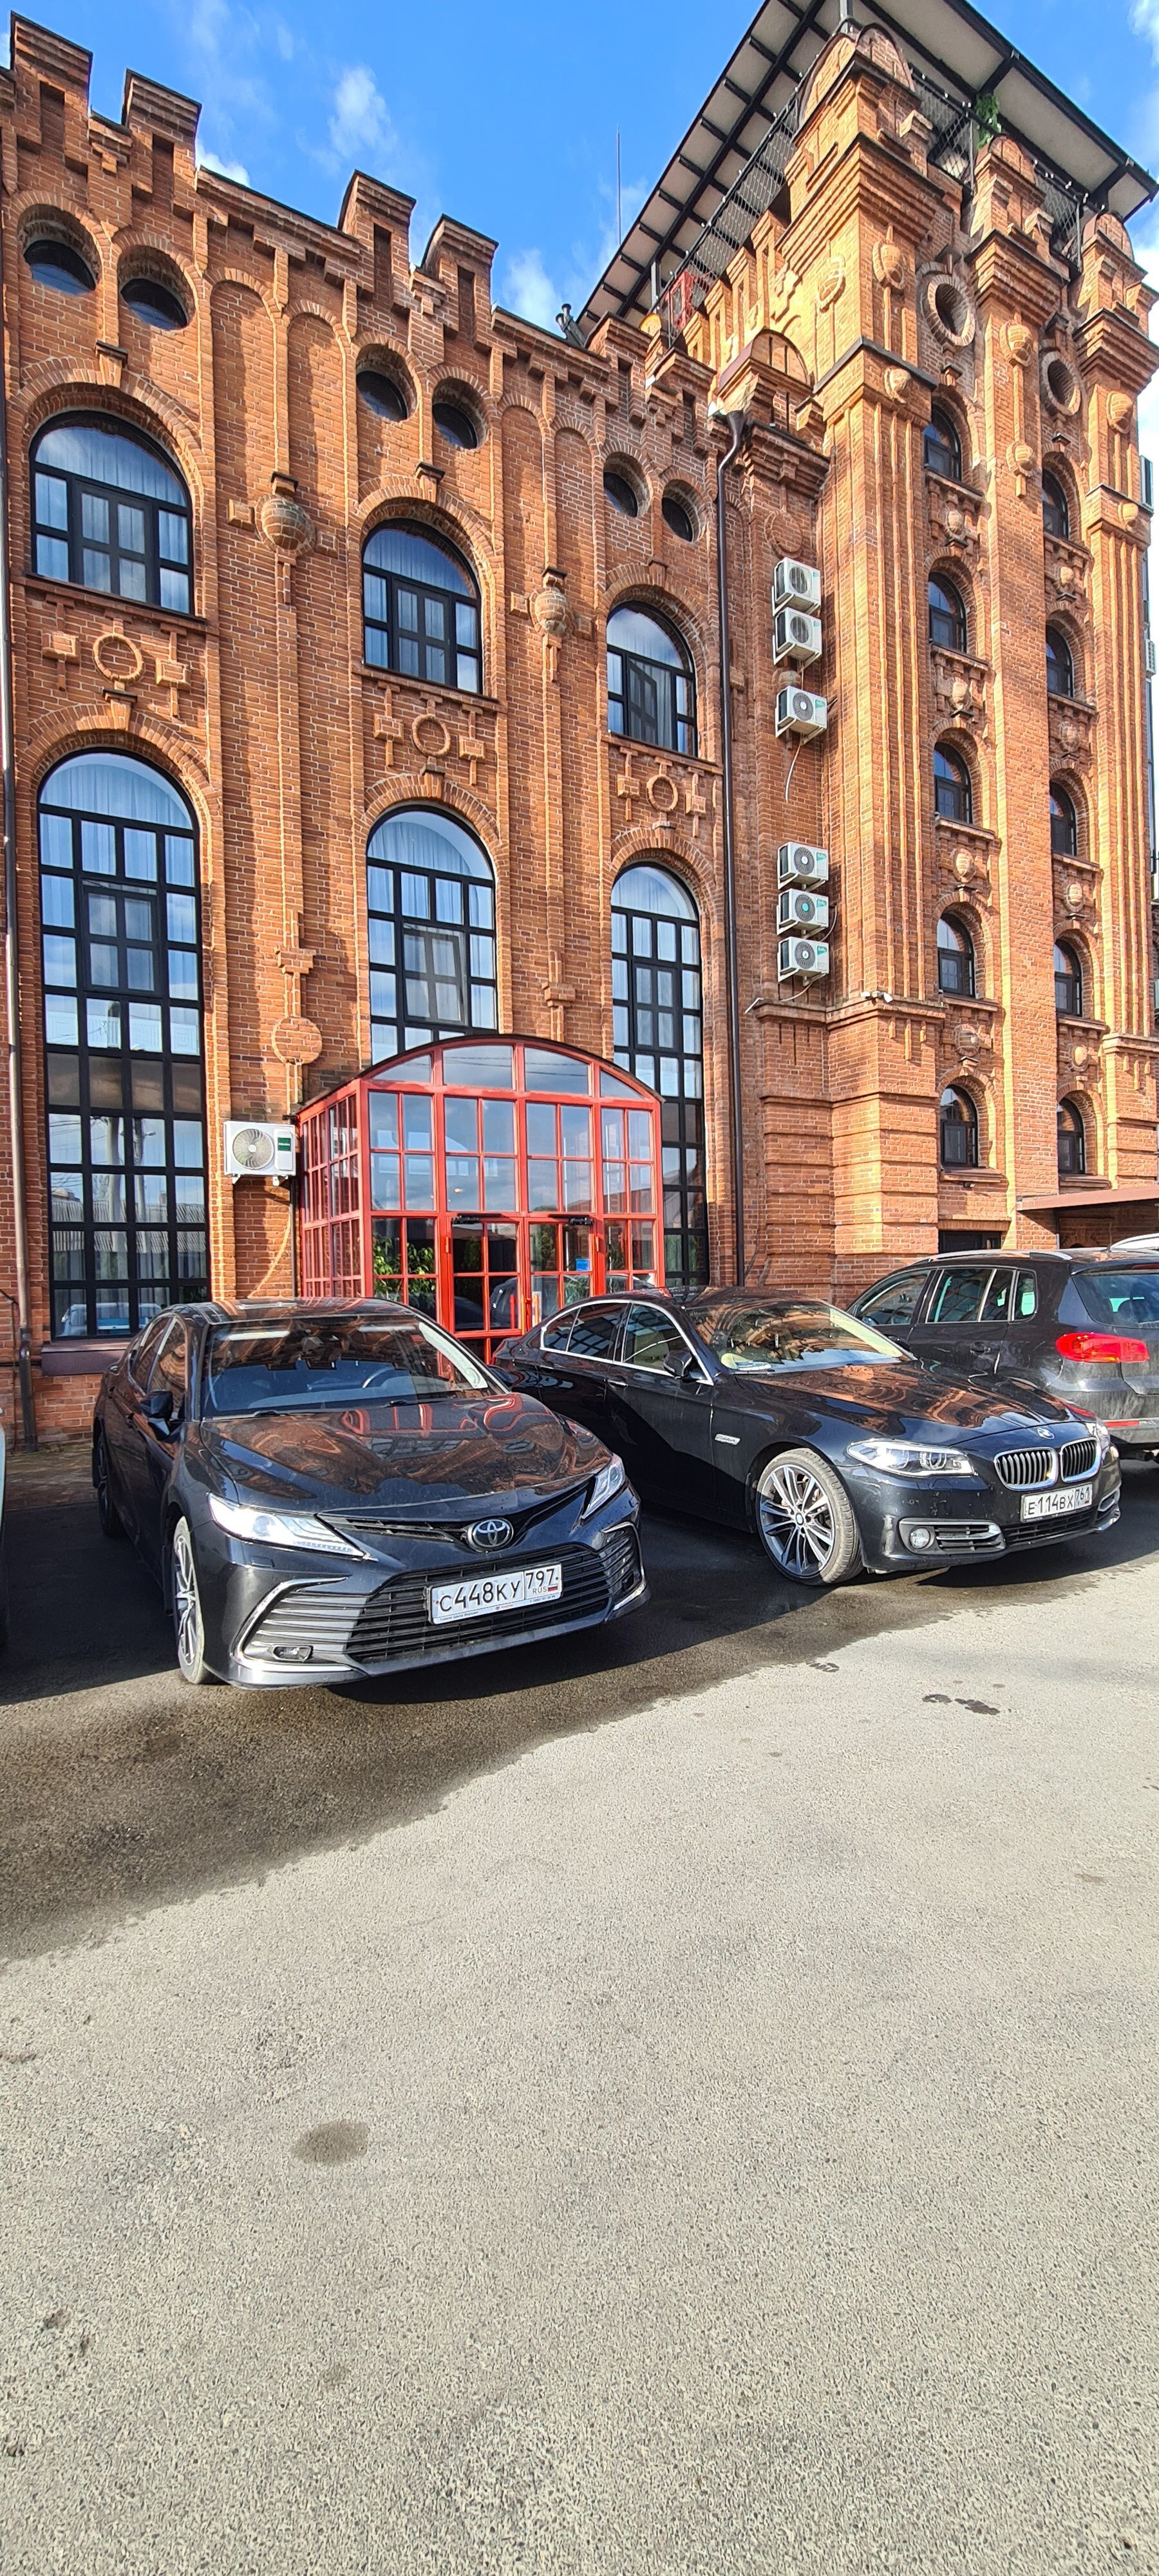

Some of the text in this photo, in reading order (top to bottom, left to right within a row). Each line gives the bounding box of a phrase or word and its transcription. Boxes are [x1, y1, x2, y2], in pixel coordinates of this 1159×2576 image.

[1075, 1486, 1090, 1502] 761
[525, 1567, 555, 1589] 797
[532, 1586, 547, 1595] RUS
